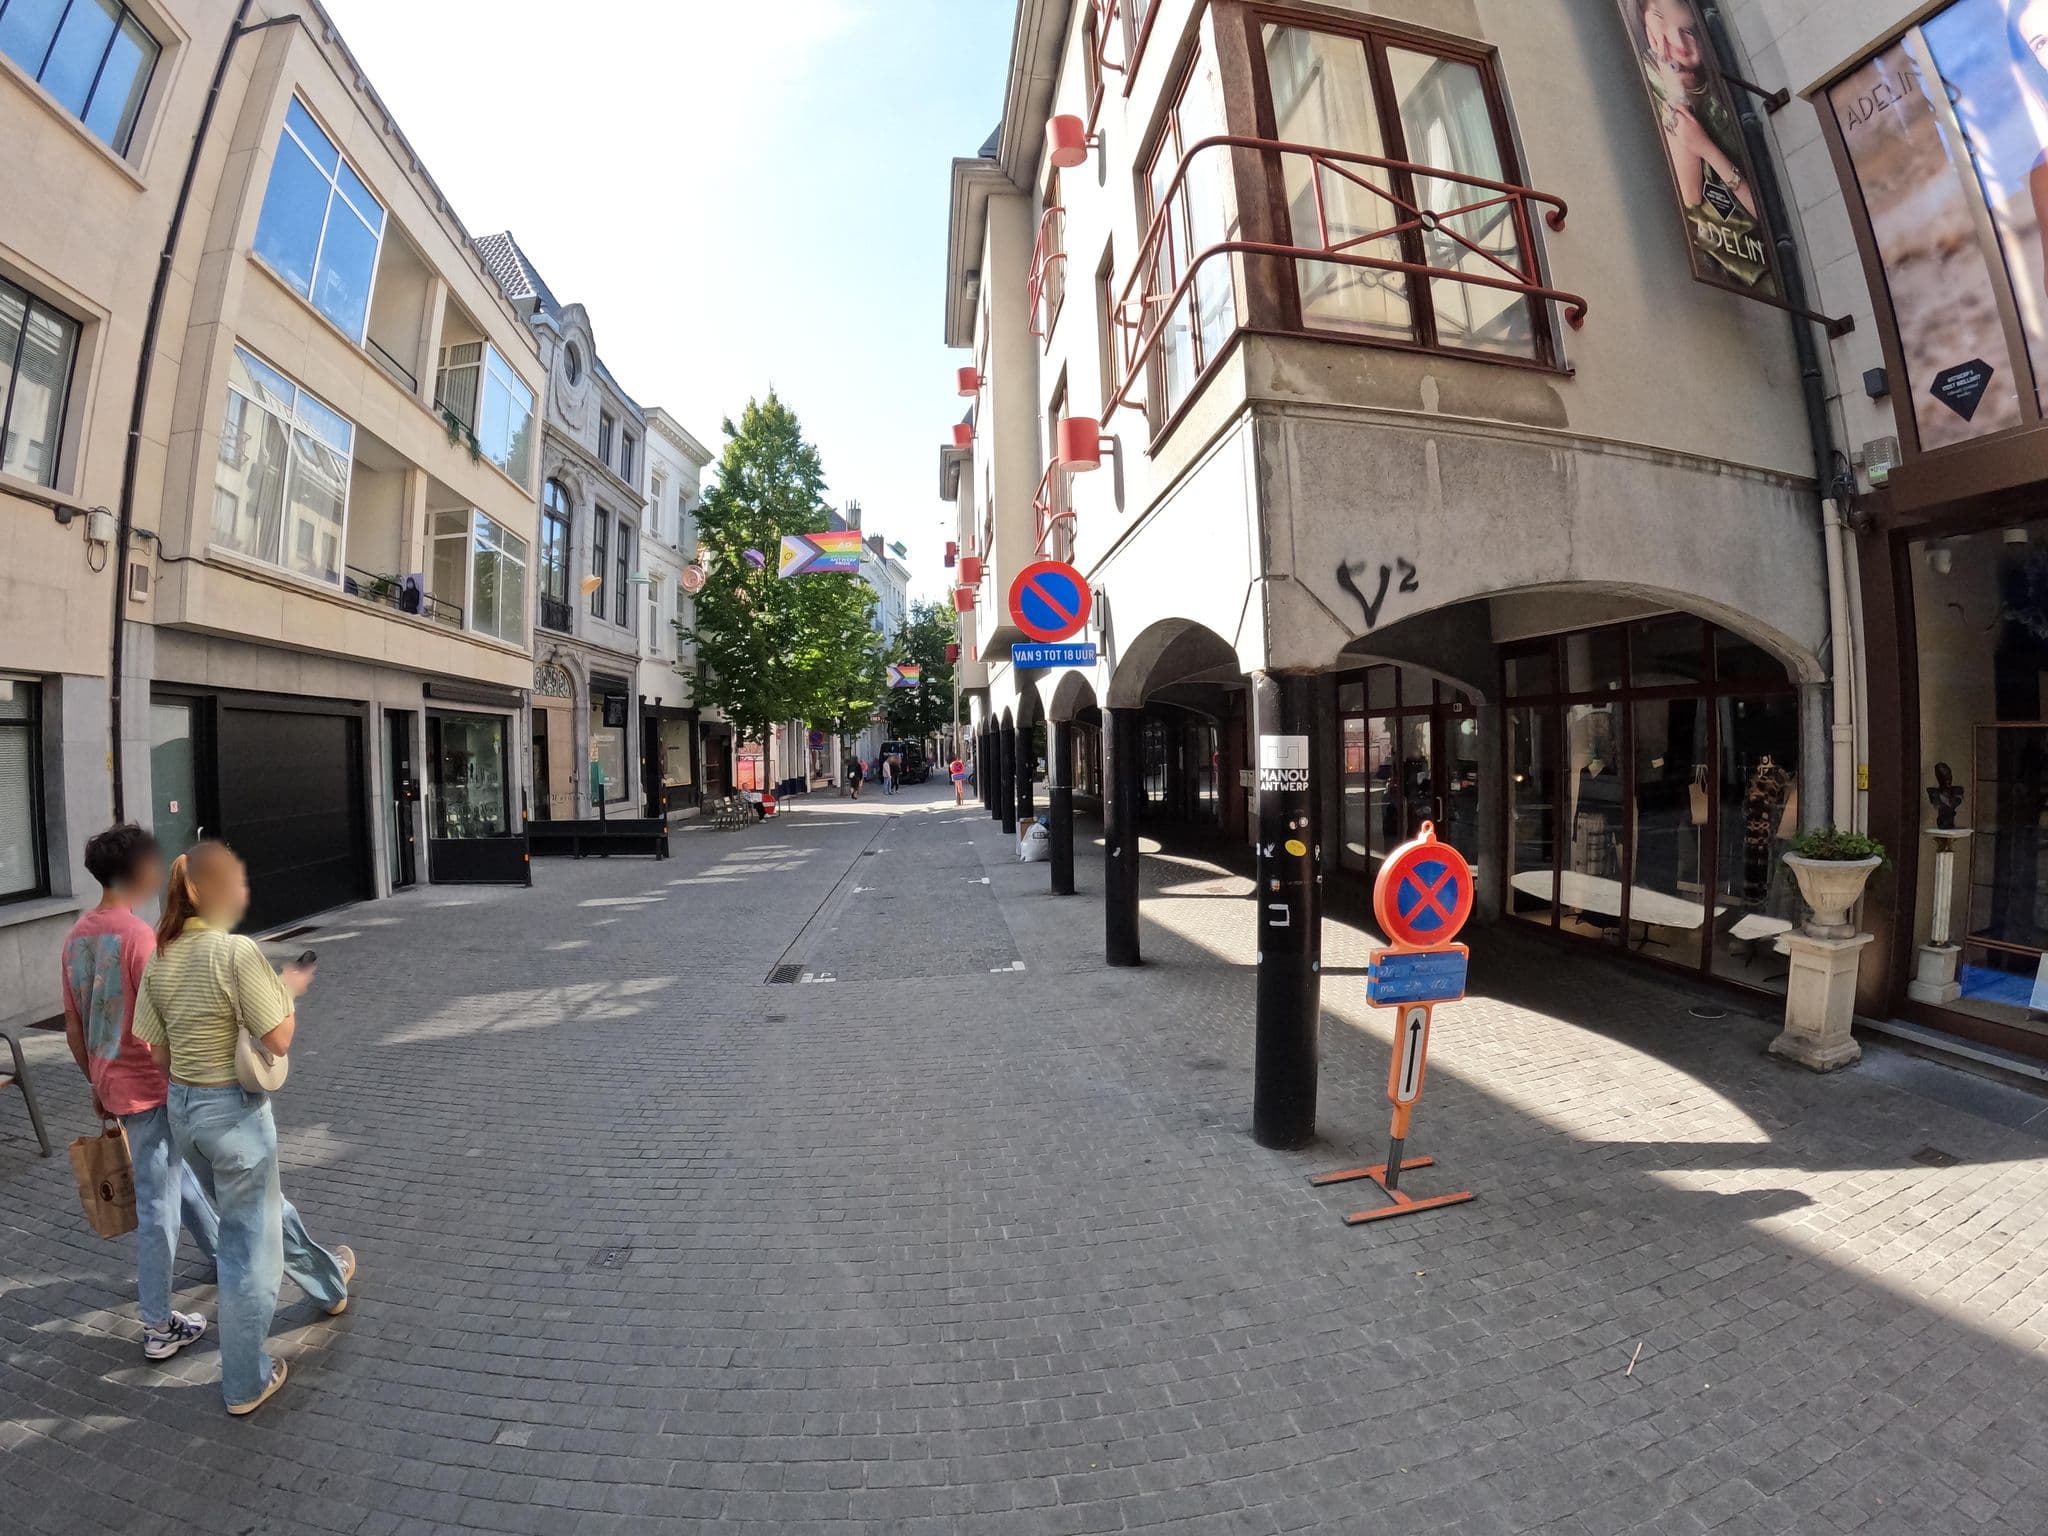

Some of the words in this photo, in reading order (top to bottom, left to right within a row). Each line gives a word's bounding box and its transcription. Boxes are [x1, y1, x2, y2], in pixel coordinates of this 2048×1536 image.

[1014, 650, 1034, 662] VAN
[1035, 650, 1042, 661] 9
[1043, 649, 1062, 661] TOT
[1063, 649, 1074, 661] 18
[1075, 649, 1095, 661] UUR
[1260, 769, 1309, 781] MANOU
[1260, 781, 1309, 792] ANTWERP
